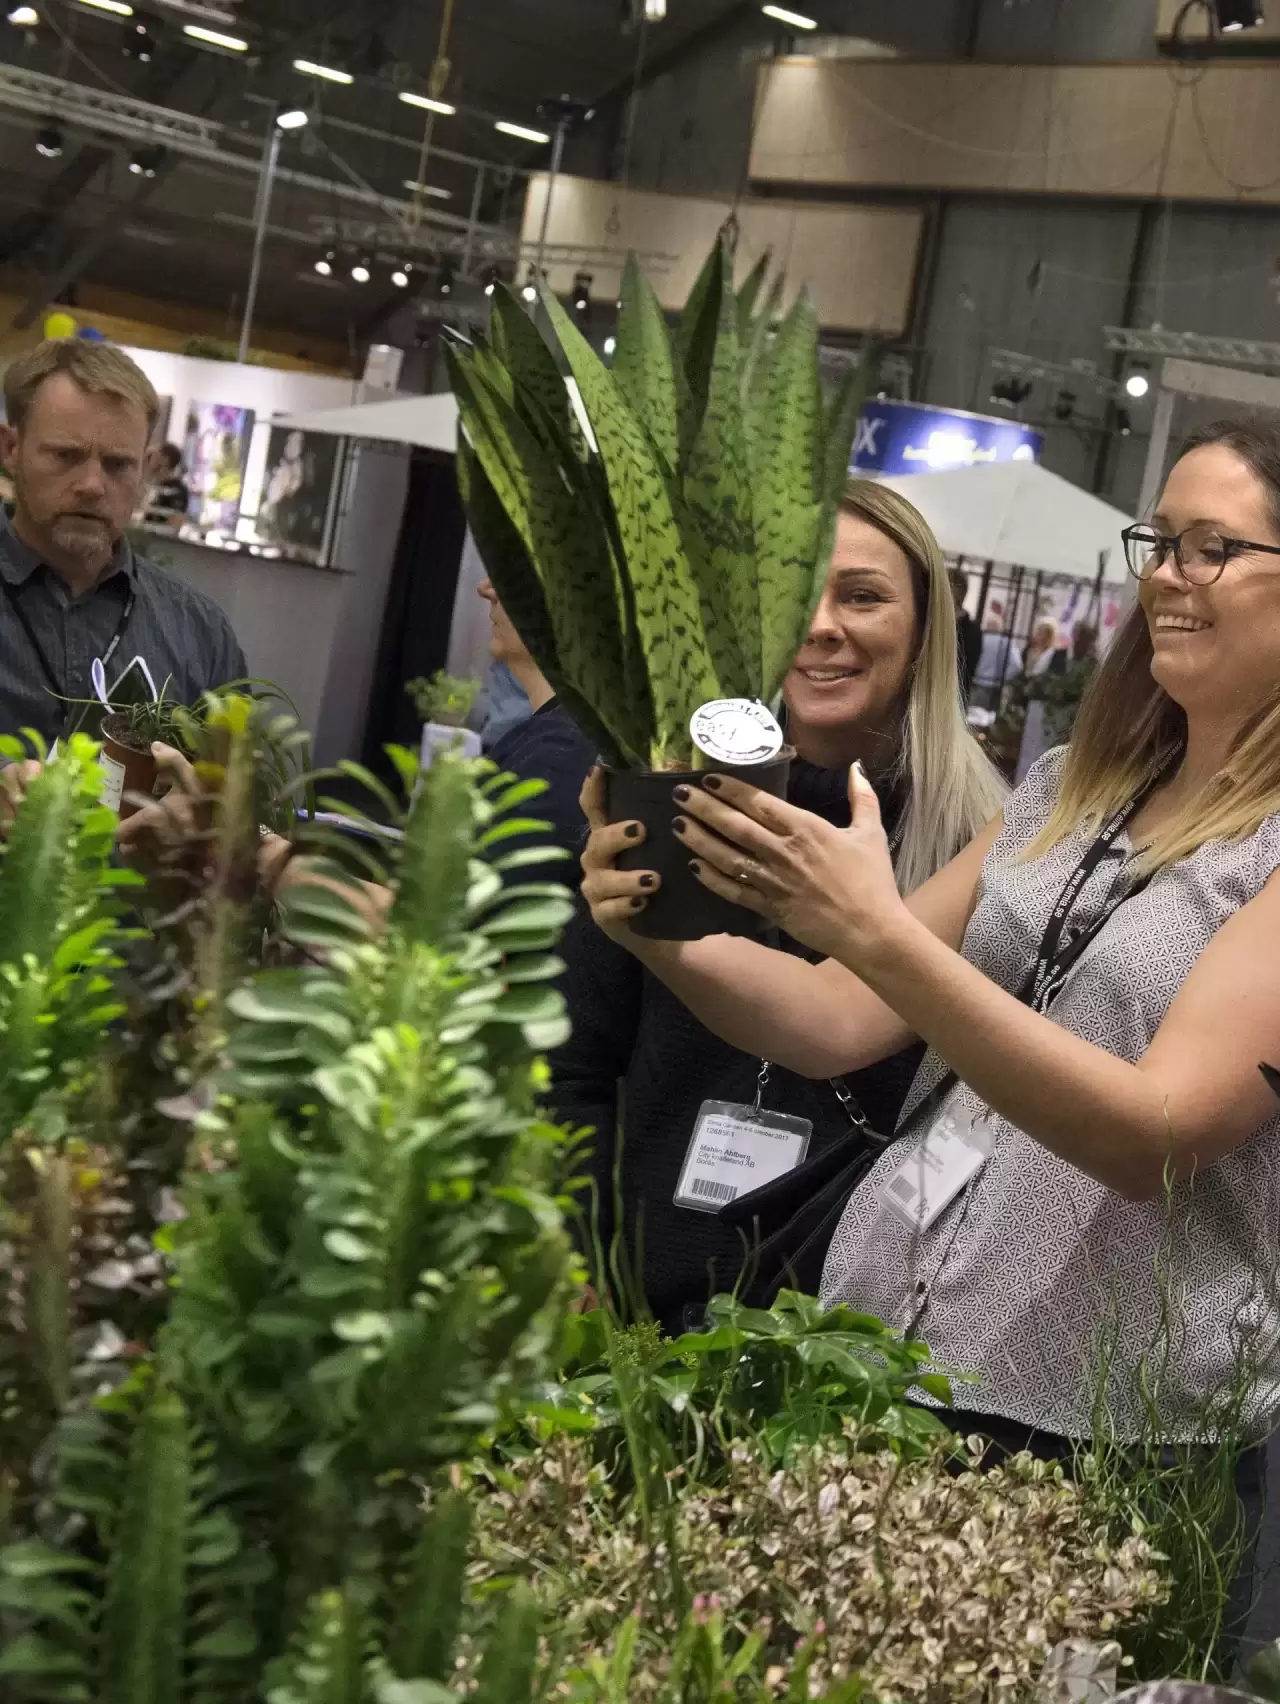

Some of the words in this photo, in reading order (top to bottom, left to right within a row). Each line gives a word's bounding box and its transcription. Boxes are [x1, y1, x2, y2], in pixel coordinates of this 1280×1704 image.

[1101, 801, 1136, 841] www.elmia.se
[1053, 868, 1087, 919] www.elmia.se
[774, 1132, 789, 1141] 2017
